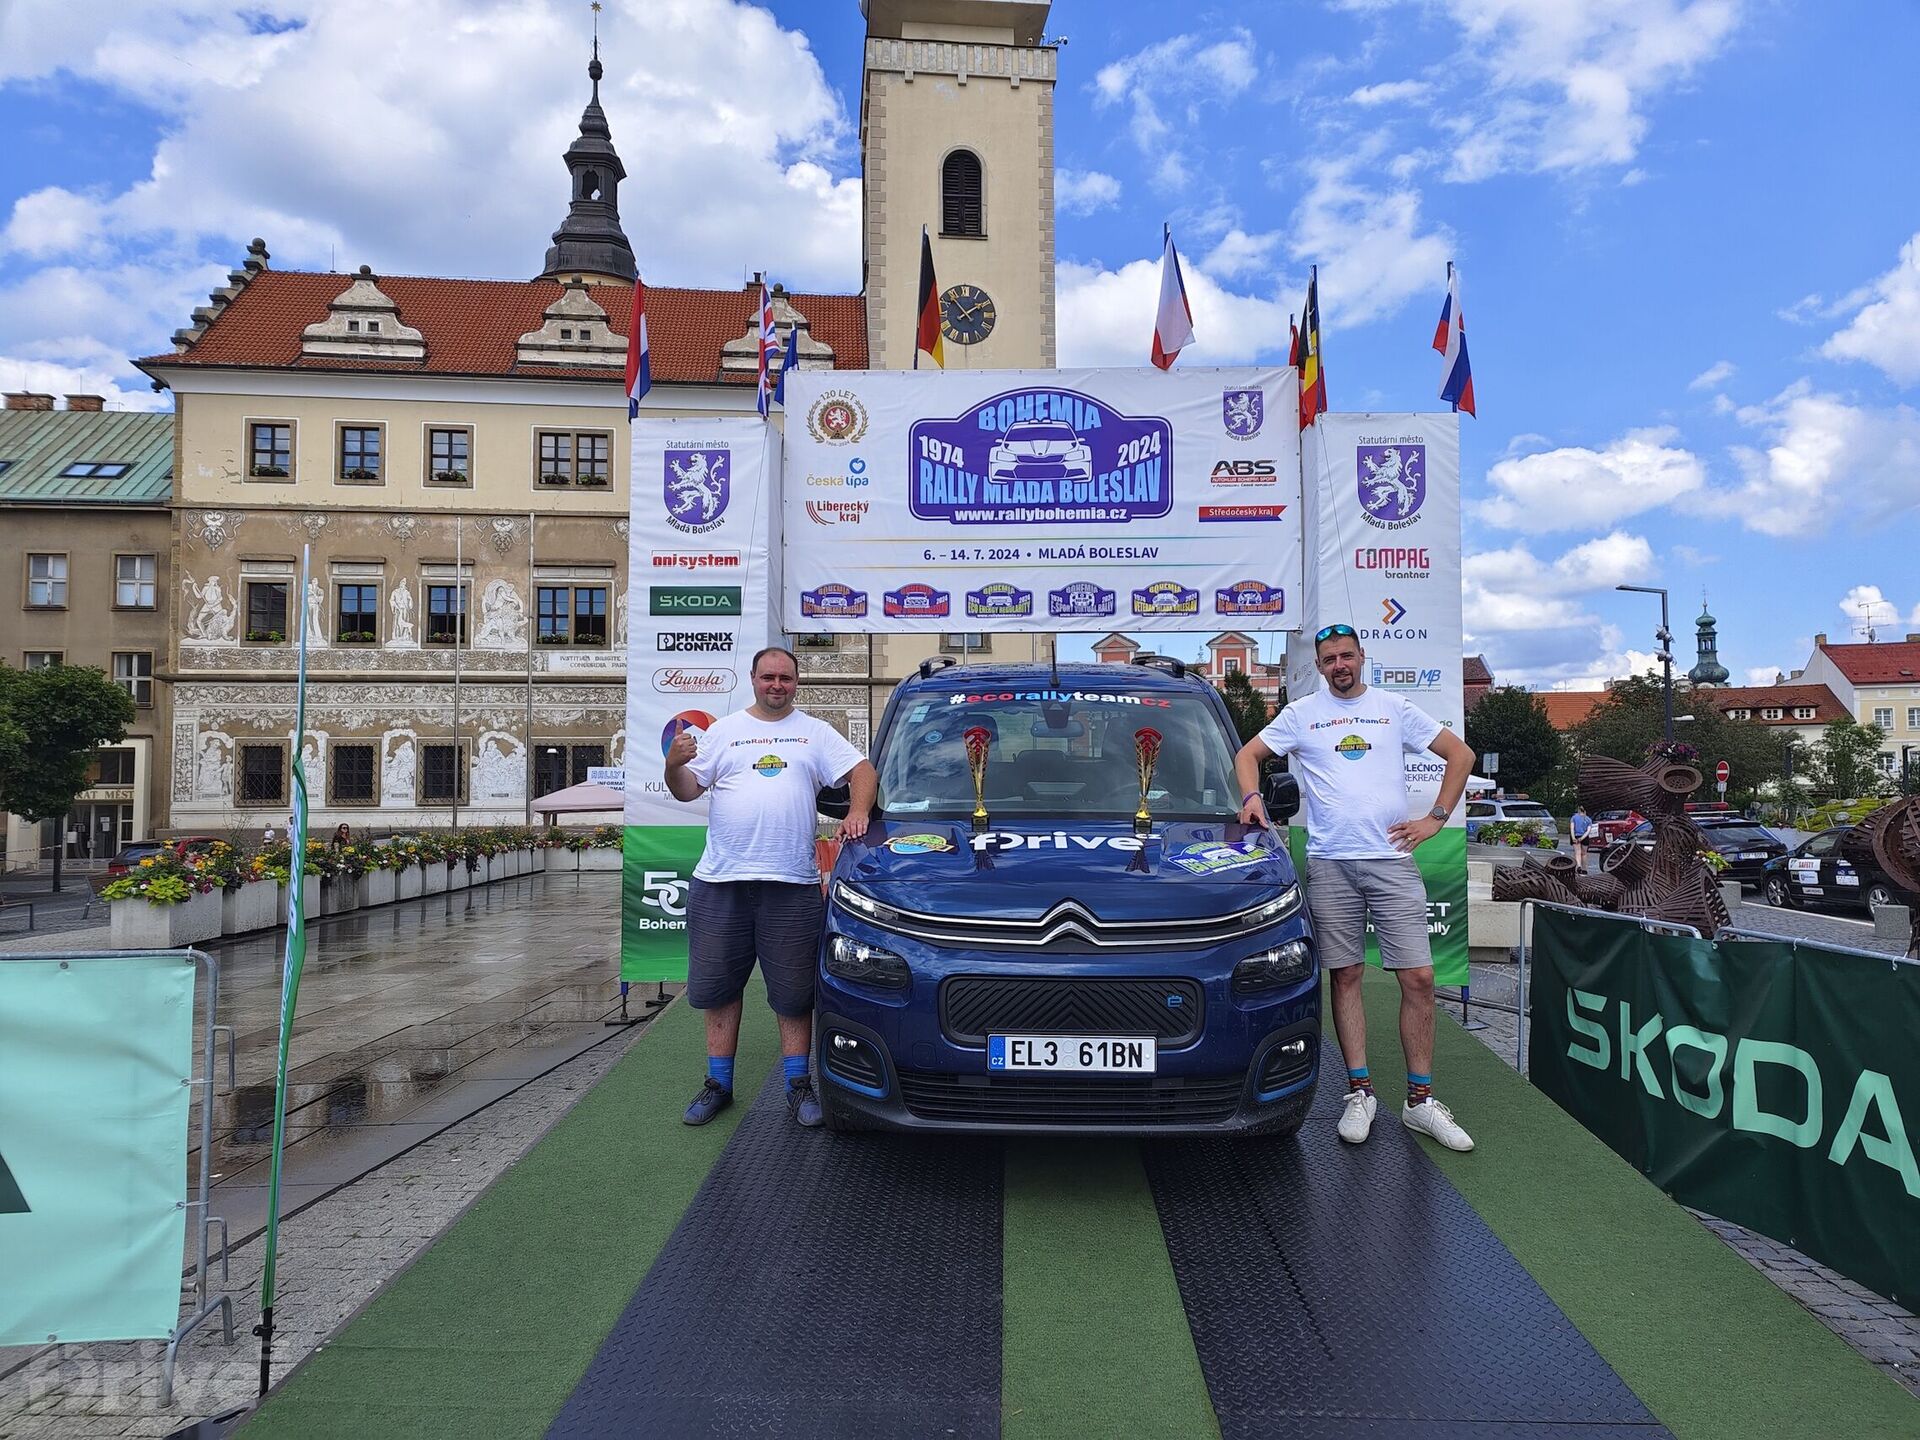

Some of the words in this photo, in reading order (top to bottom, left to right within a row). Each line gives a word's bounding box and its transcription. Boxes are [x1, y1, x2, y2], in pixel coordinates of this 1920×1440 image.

[820, 390, 837, 400] 120
[838, 389, 857, 401] LET
[978, 394, 1102, 433] BOHEMIA
[666, 440, 704, 449] Statutární
[706, 440, 729, 449] město
[1358, 435, 1398, 444] Statutární
[1399, 435, 1424, 444] město
[918, 435, 965, 468] 1974
[1117, 430, 1162, 467] 2024
[1211, 460, 1275, 475] ABS
[807, 474, 844, 486] Česká
[846, 475, 869, 488] lípa
[919, 458, 980, 505] RALLY
[1059, 455, 1163, 504] BOLESLAV
[817, 500, 869, 513] Liberecký
[1209, 507, 1258, 516] Středočeský
[1258, 507, 1274, 516] kraj
[839, 512, 861, 524] kraj
[954, 507, 1128, 521] www.rallybohemia.cz
[665, 515, 691, 534] Mladá
[692, 517, 726, 534] Boleslav
[1360, 512, 1386, 530] Mladá
[1387, 513, 1422, 531] Boleslav
[923, 549, 936, 560] 6.
[950, 549, 970, 560] 14.
[974, 549, 985, 560] 7.
[988, 549, 1020, 559] 2024
[1038, 545, 1085, 559] MLADÁ
[1089, 547, 1159, 558] BOLESLAV
[1355, 549, 1430, 569] COMPAG
[1385, 570, 1430, 578] brantner
[1361, 629, 1427, 639] DRAGON
[676, 643, 733, 651] CONTACT
[950, 691, 1171, 709] #ecorallyteamcz
[1309, 717, 1390, 730] #EcoRallyTeamCZ
[969, 831, 1144, 851] fDrive
[991, 1057, 1004, 1065] CZ
[1011, 1041, 1058, 1066] EL3
[1079, 1042, 1143, 1068] 61BN
